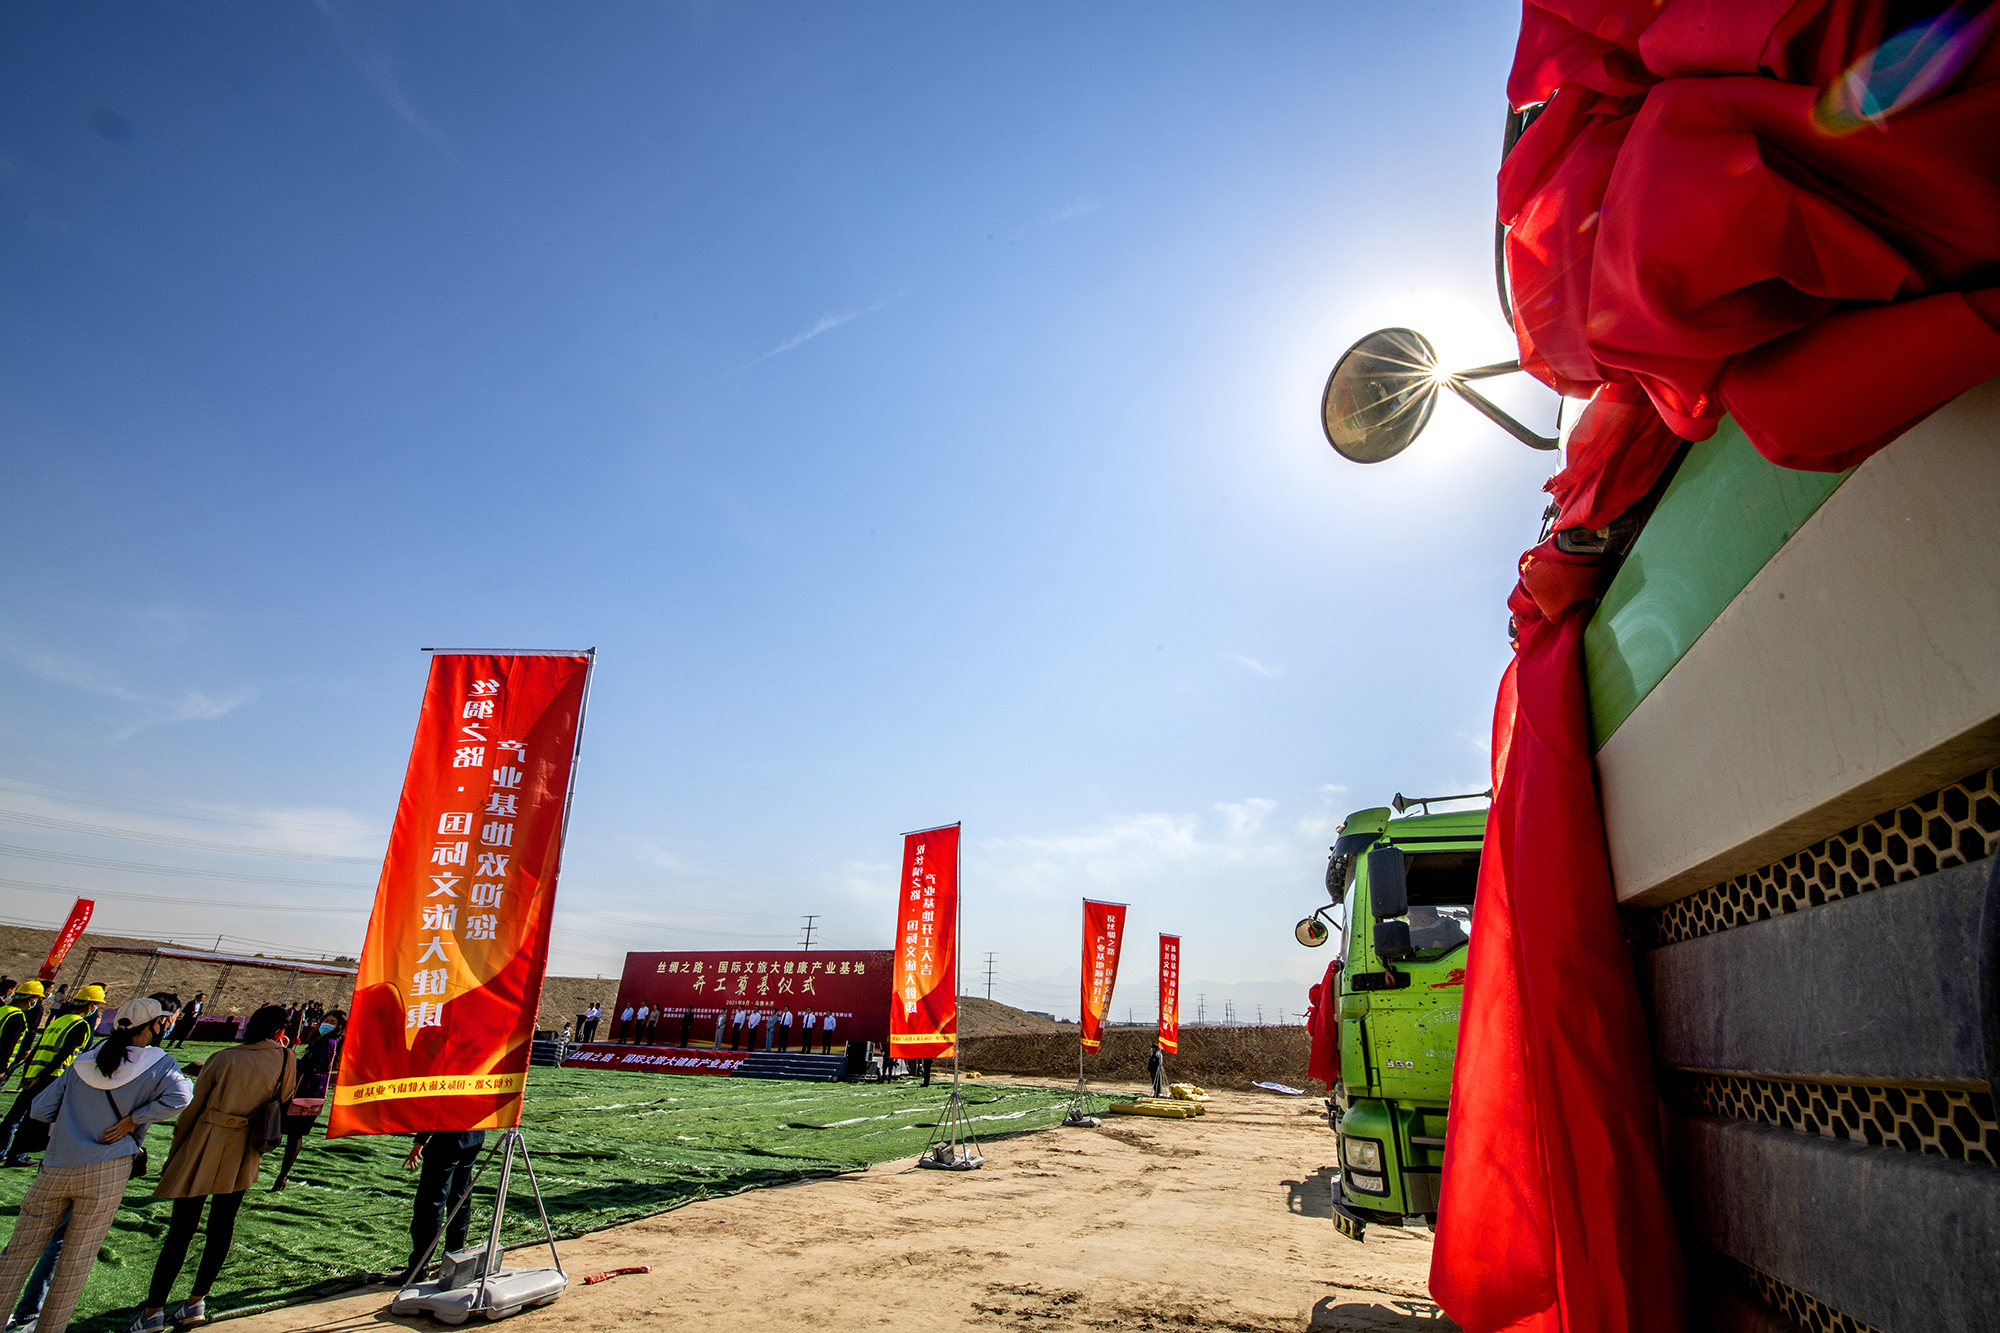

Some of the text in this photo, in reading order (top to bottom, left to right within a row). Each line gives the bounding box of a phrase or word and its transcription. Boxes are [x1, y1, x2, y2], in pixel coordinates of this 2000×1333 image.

[656, 960, 866, 975] 丝绸之路·国际文旅大健康产业基地
[692, 973, 816, 996] 开工奠基仪式
